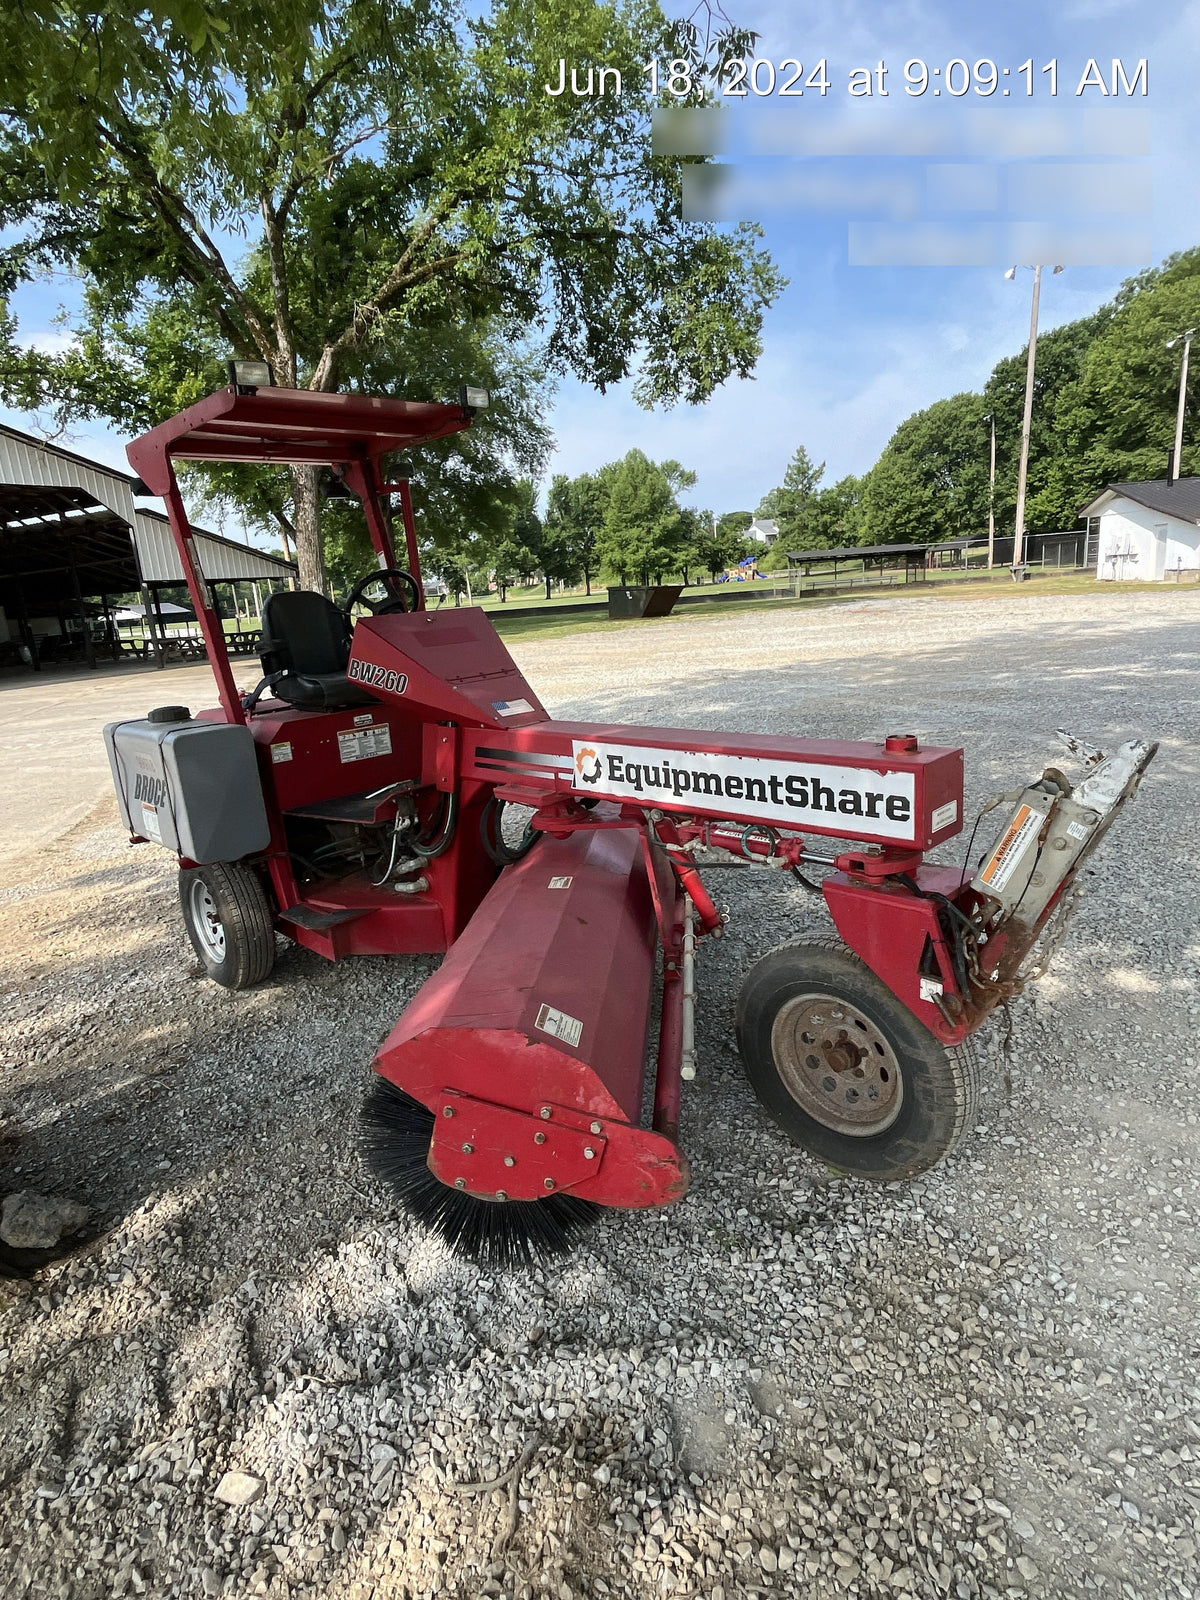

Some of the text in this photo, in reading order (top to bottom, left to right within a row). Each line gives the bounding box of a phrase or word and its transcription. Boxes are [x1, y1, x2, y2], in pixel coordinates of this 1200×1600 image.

[348, 659, 408, 694] BW260
[134, 773, 167, 808] BROCE
[607, 754, 911, 823] EquipmentShare
[998, 828, 1017, 857] WARNING
